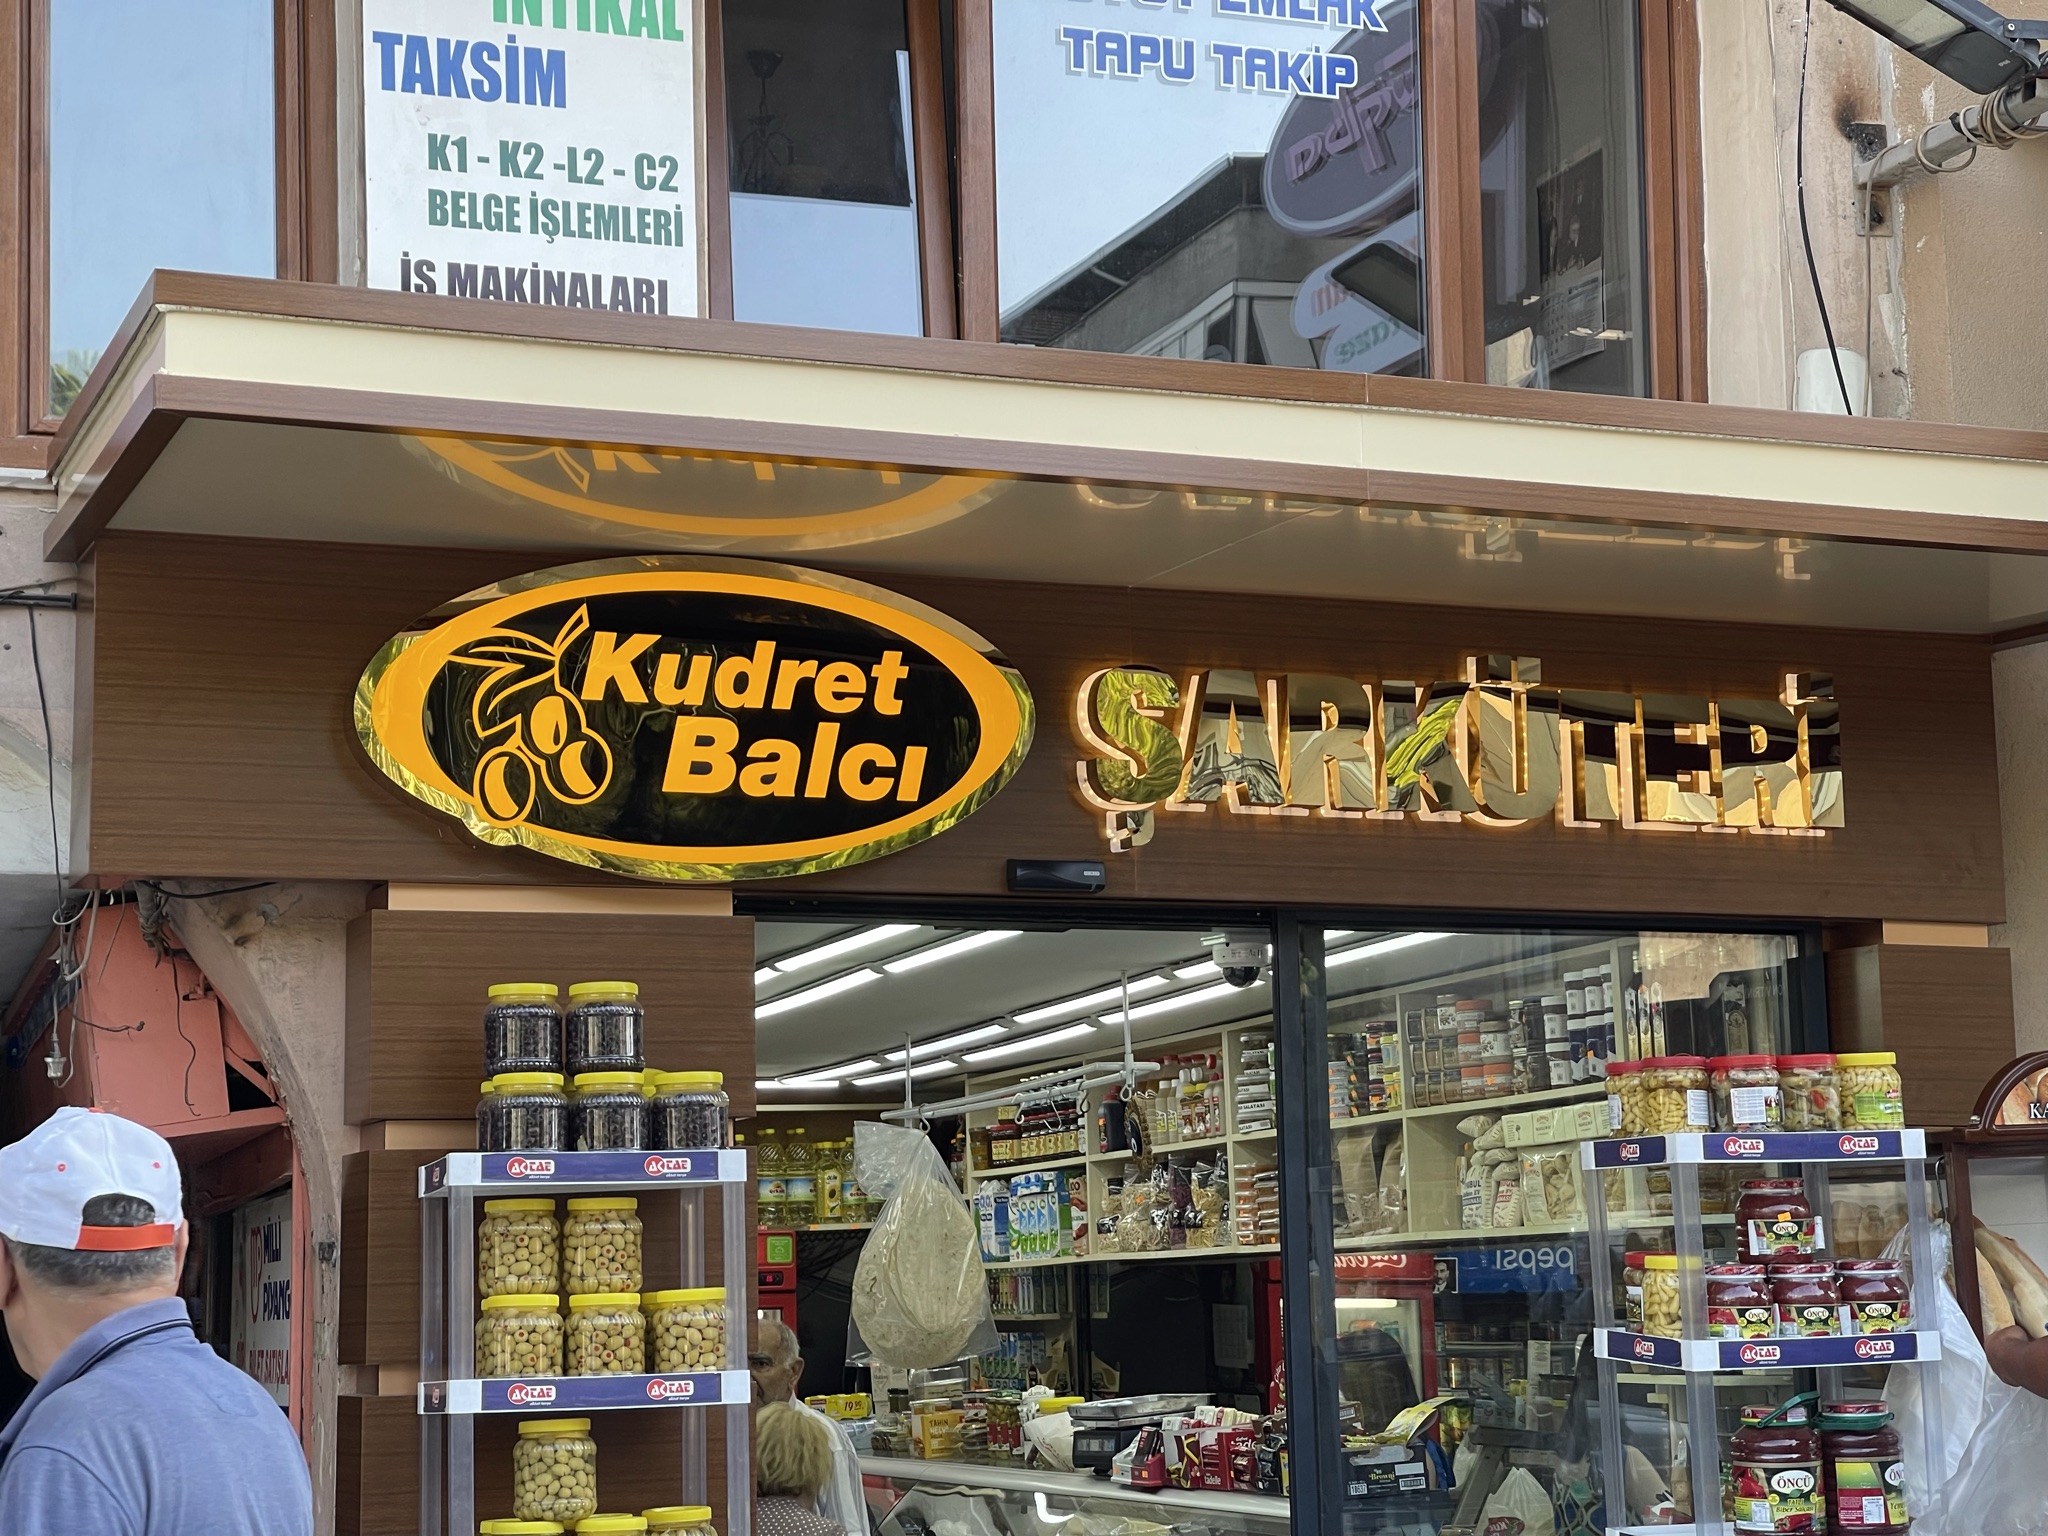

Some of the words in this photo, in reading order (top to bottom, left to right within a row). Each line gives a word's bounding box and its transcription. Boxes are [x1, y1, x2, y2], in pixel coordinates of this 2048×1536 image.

[372, 33, 567, 109] TAKSİM
[1061, 25, 1196, 82] TAPU
[1211, 42, 1358, 99] TAKİP
[427, 133, 468, 173] K1
[499, 139, 545, 180] K2
[634, 153, 679, 192] C2
[428, 188, 522, 234] BELGE
[529, 190, 684, 248] İŞLEMLERİ
[580, 631, 908, 716] Kudret
[661, 715, 929, 803] Balcı
[1072, 653, 1847, 854] ŞARKÜTERİ
[263, 1216, 282, 1265] MİLLİ
[1777, 1474, 1812, 1488] ÖNCÜ
